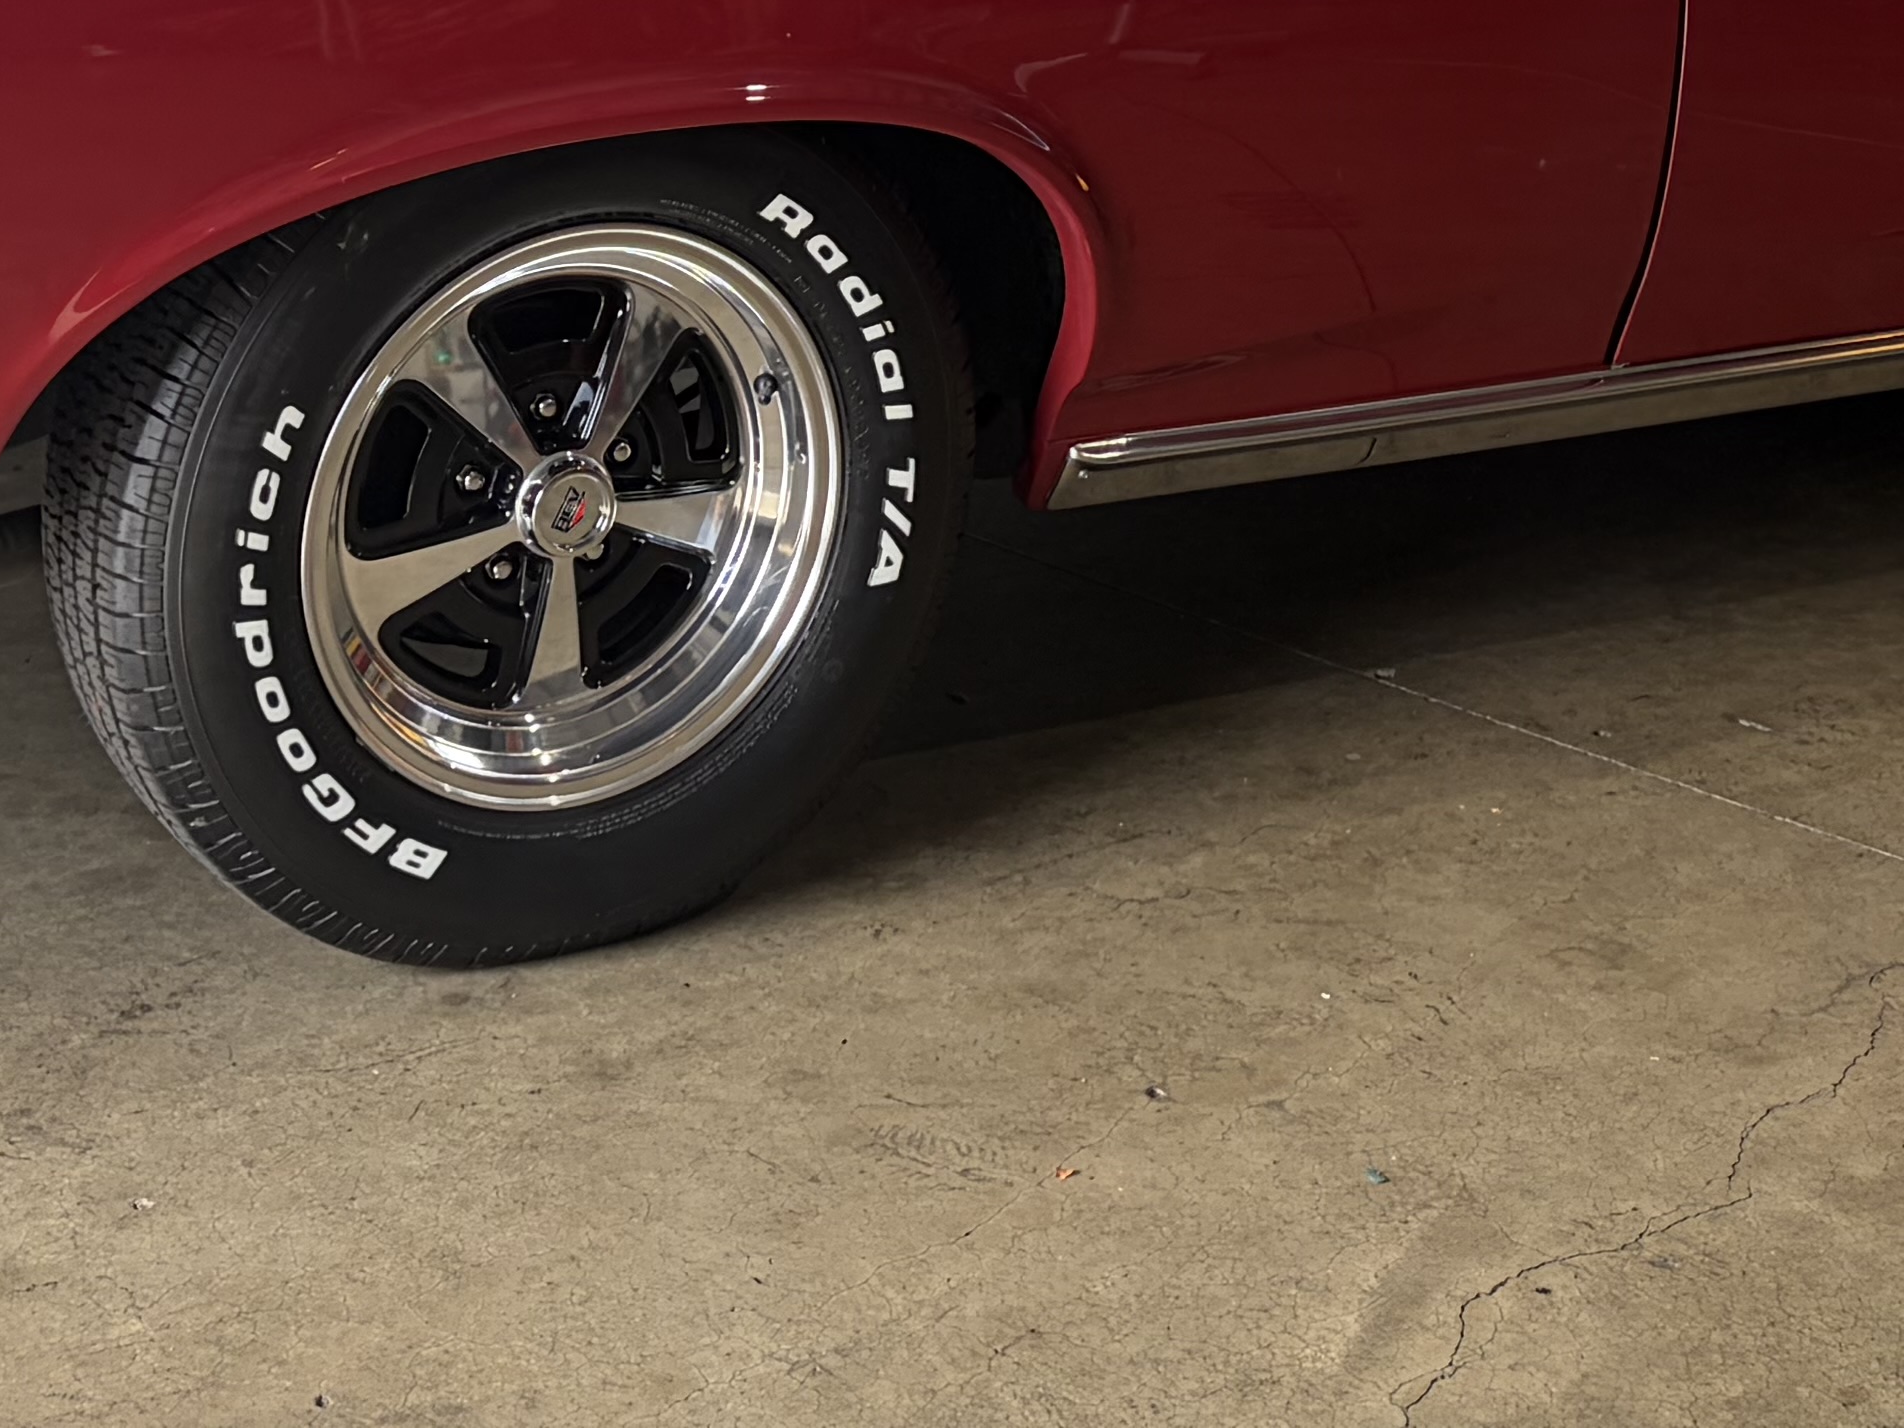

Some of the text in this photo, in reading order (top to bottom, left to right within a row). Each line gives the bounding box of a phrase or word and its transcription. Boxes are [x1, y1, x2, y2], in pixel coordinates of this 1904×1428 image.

[757, 193, 914, 421] Radial
[867, 458, 916, 588] T/A
[234, 405, 448, 880] BFGoodrich
